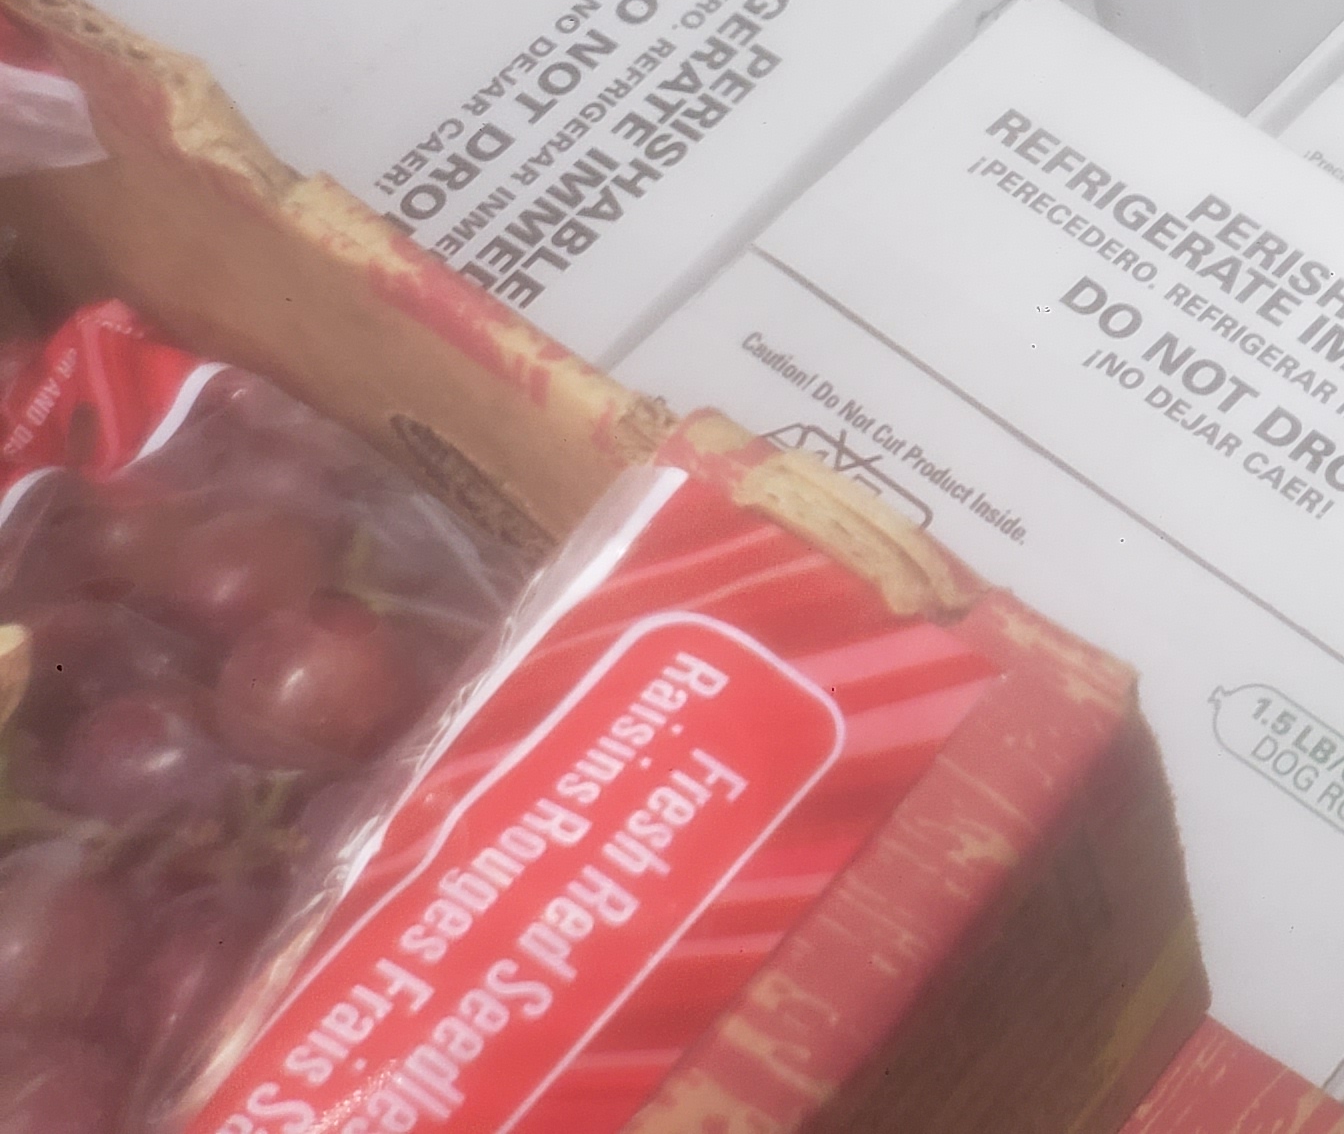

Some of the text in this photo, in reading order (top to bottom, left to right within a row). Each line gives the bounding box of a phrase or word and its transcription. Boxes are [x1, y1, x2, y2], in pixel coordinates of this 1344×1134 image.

[461, 34, 557, 119] DEJAR
[509, 36, 678, 187] REFRIGERAR
[514, 28, 620, 126] NOT
[373, 117, 465, 196] CAER!
[493, 43, 784, 311] PERISHABLE
[983, 106, 1304, 329] REFRIGERATE
[965, 153, 1161, 294] ¡PERECEDERO.
[1163, 281, 1335, 411] REFRIGERAR
[1057, 274, 1145, 341] DO
[1139, 328, 1262, 418] NOT
[740, 330, 1029, 548] Caution! Do Not Cut Product Inside.
[1080, 347, 1336, 524] ¡NO DEJAR CAER!
[1249, 733, 1321, 794] DOG
[1250, 696, 1298, 737] 1.5
[283, 649, 731, 1088] Raisins Rouges Frais
[601, 747, 750, 878] Fresh
[516, 863, 641, 984] Red
